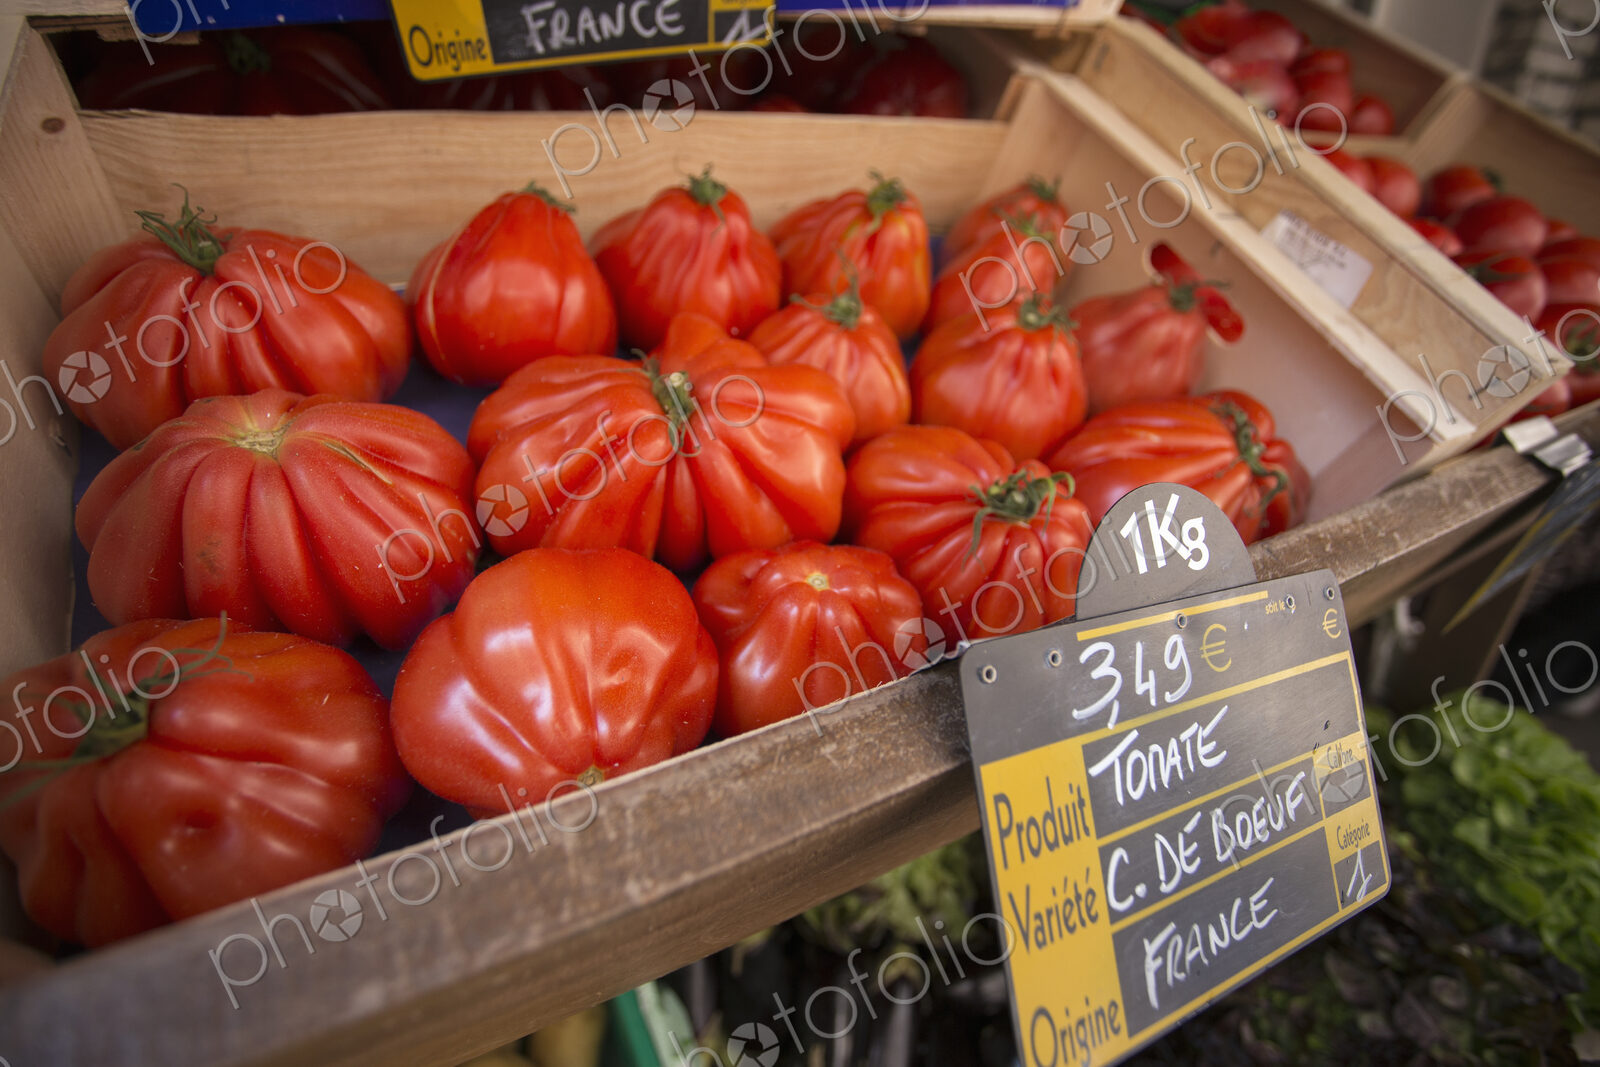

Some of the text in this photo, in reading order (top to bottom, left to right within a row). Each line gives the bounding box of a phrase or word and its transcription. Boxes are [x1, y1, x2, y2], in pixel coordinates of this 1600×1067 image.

[408, 24, 487, 72] Origine
[521, 0, 685, 54] FRANCE
[1120, 493, 1210, 575] 1Kg
[1322, 608, 1342, 639] €
[1072, 623, 1232, 730] 3,49 €
[1088, 704, 1229, 807] TOMATE
[993, 775, 1091, 871] Produit
[1107, 846, 1147, 912] C.
[1211, 771, 1306, 863] BOEUF
[1336, 819, 1371, 851] Catégorie
[1007, 866, 1099, 955] Variété
[1143, 877, 1279, 1011] FRANCE
[1030, 995, 1122, 1067] Origine
